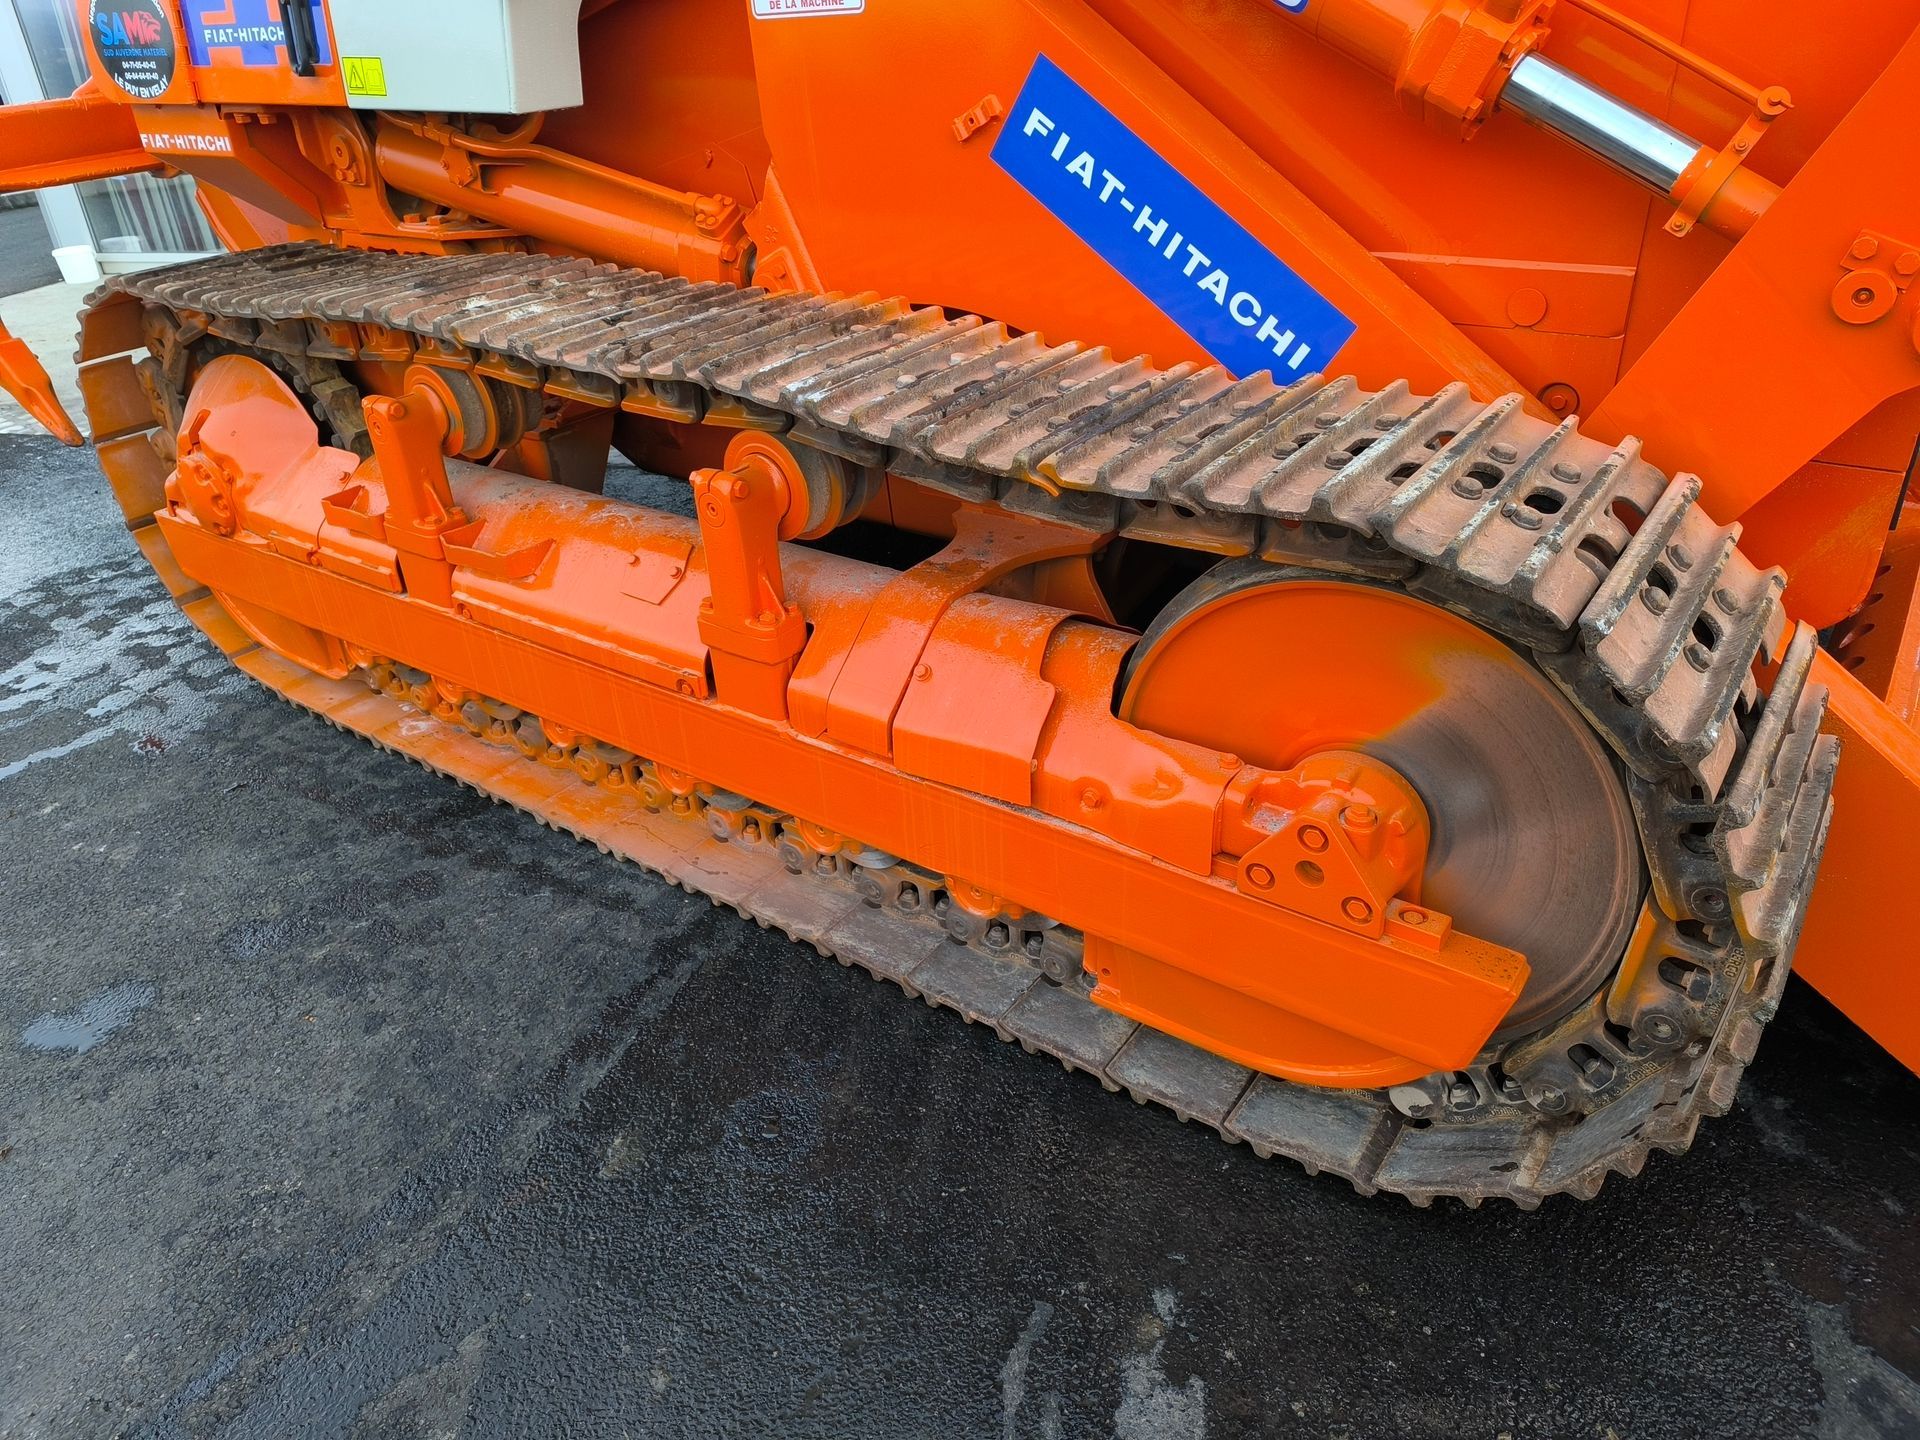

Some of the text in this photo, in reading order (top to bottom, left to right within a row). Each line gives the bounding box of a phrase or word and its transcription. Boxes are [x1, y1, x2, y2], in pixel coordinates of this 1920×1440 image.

[770, 0, 782, 10] DE
[785, 0, 798, 9] LA
[97, 12, 148, 46] SAM
[203, 26, 286, 44] FIAT-HITACH
[103, 48, 115, 58] SUD
[115, 48, 143, 58] AUVERGNE
[114, 73, 169, 98] LE PUY EN VELAY
[140, 133, 232, 152] FIAT-HITACHI
[1023, 107, 1312, 371] FIAT-HITACHI
